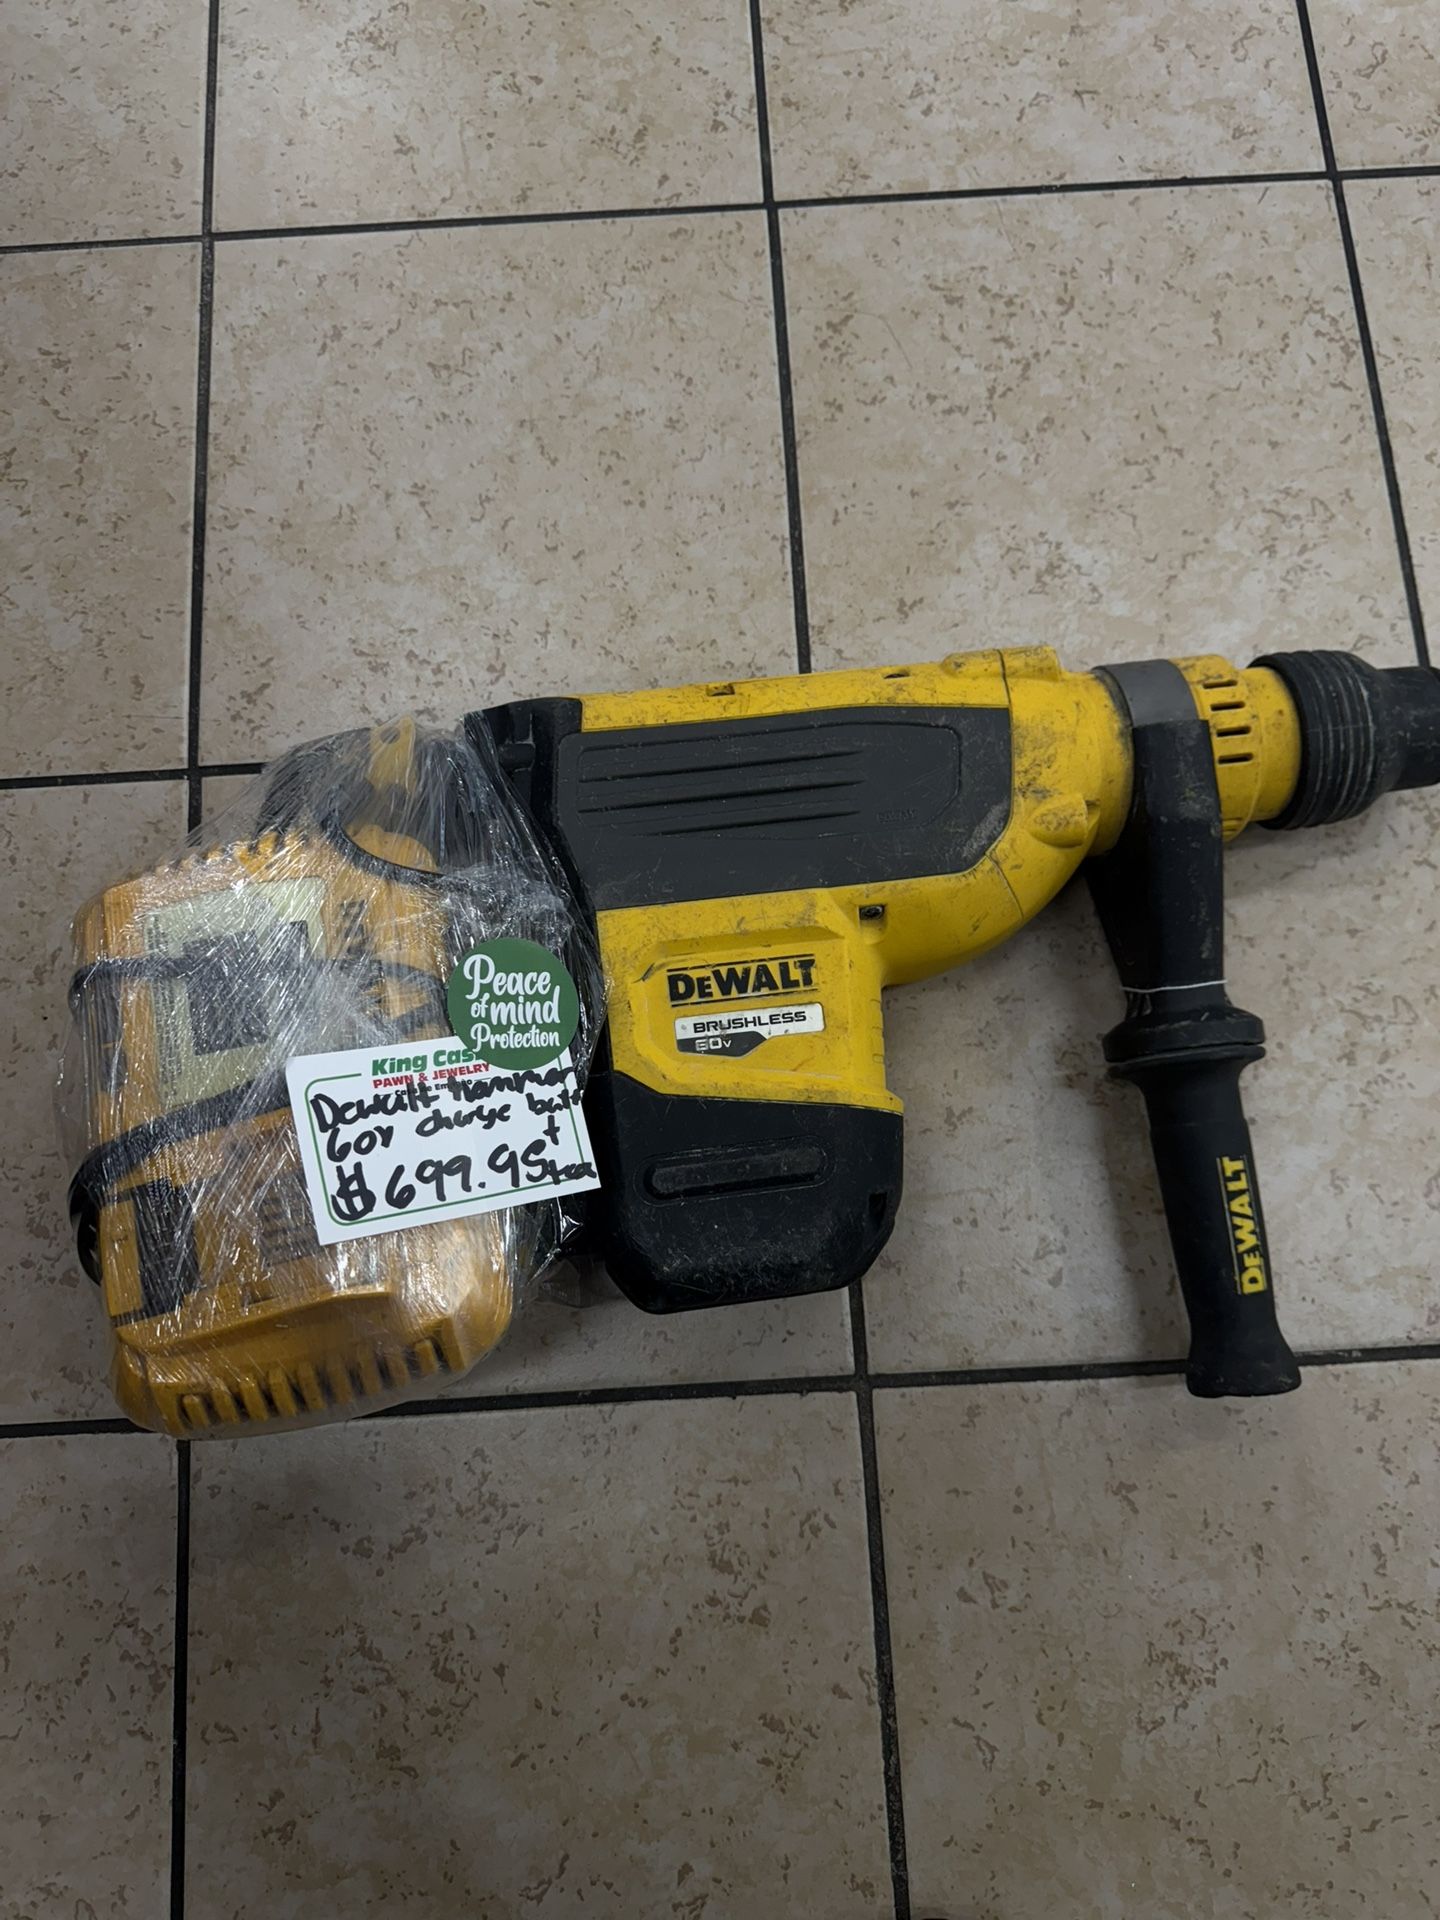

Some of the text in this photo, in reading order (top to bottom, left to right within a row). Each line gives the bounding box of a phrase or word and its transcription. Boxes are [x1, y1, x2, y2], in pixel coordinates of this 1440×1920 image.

[463, 954, 551, 999] Peace
[667, 958, 816, 1002] DEWALT
[470, 985, 560, 1026] of mind
[693, 1010, 807, 1034] BRUSHLESS
[470, 1022, 560, 1052] Protection
[371, 1048, 481, 1077] King Cas
[373, 1062, 490, 1089] PAWN & JEWELRY
[1221, 1156, 1266, 1294] DEWALT
